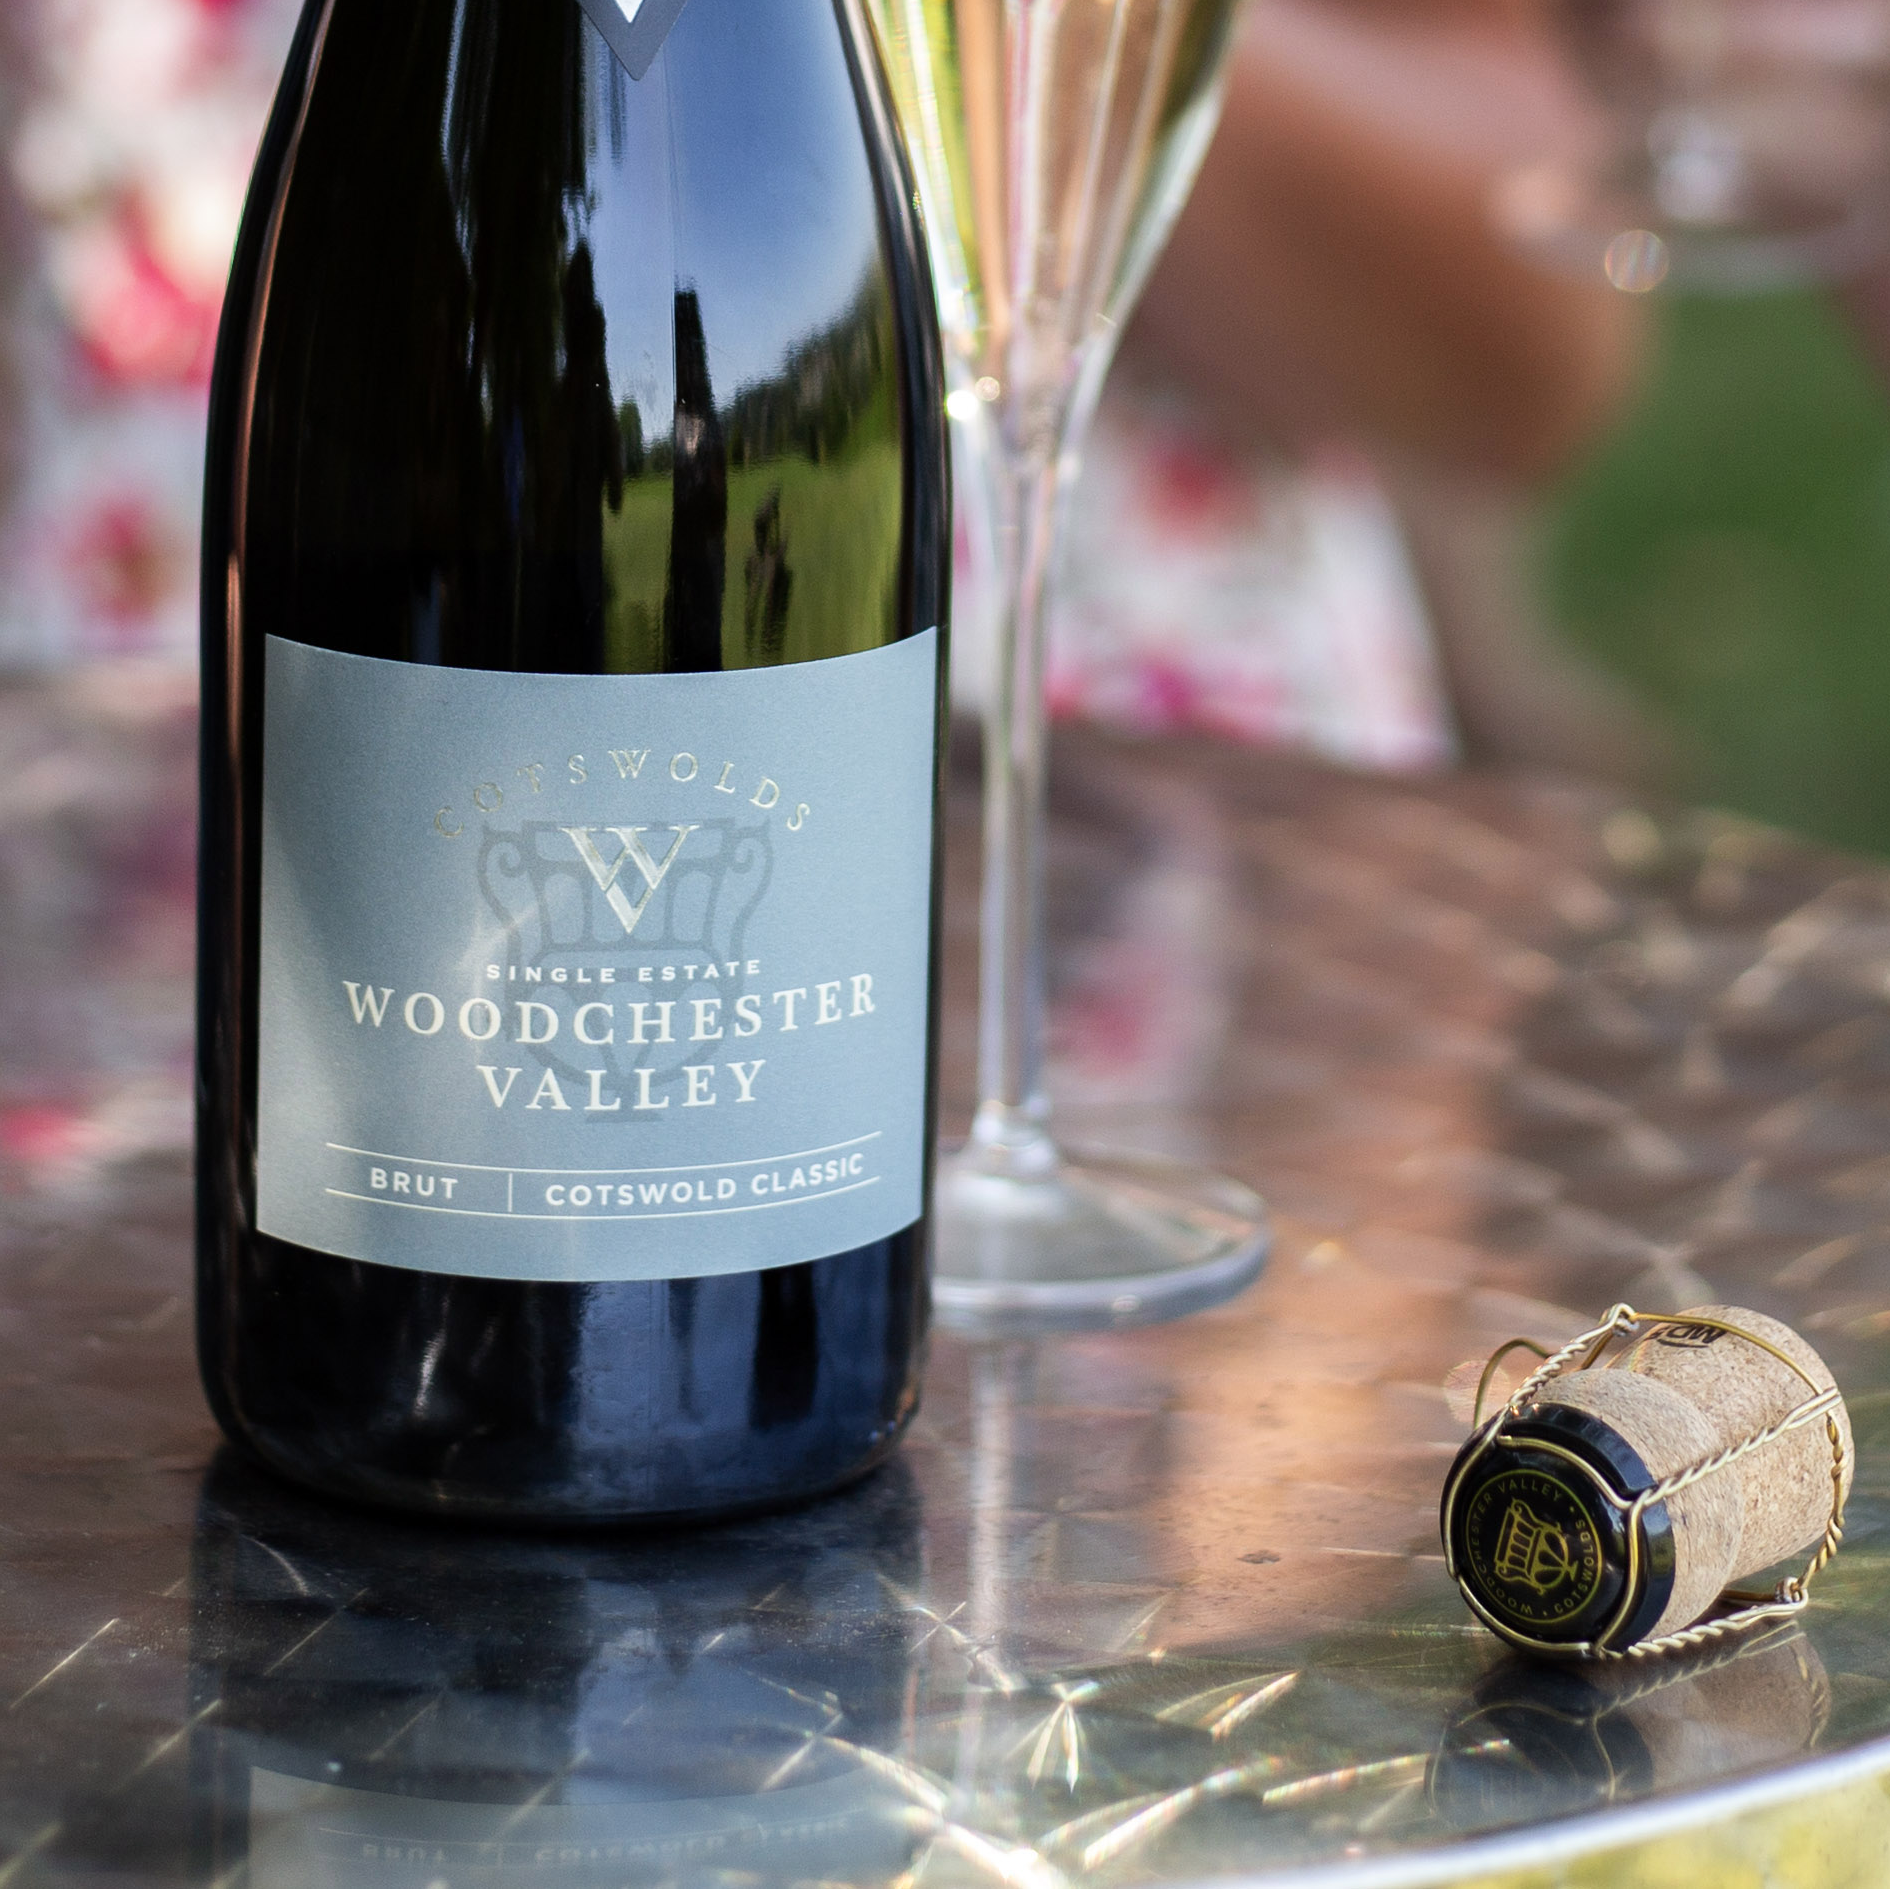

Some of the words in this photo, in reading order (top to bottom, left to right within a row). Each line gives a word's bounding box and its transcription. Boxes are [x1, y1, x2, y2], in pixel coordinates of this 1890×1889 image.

[434, 748, 811, 839] COTSWOLDS
[486, 963, 617, 984] SINGLE
[637, 959, 762, 983] ESTATE
[341, 972, 877, 1046] WOODCHESTER
[476, 1059, 767, 1112] VALLEY
[370, 1166, 460, 1200] BRUT
[544, 1176, 738, 1208] COTSWOLD
[750, 1152, 865, 1196] CLASSIC
[1498, 1477, 1562, 1502] VALLEY
[1553, 1519, 1595, 1614] COTSWOLDS
